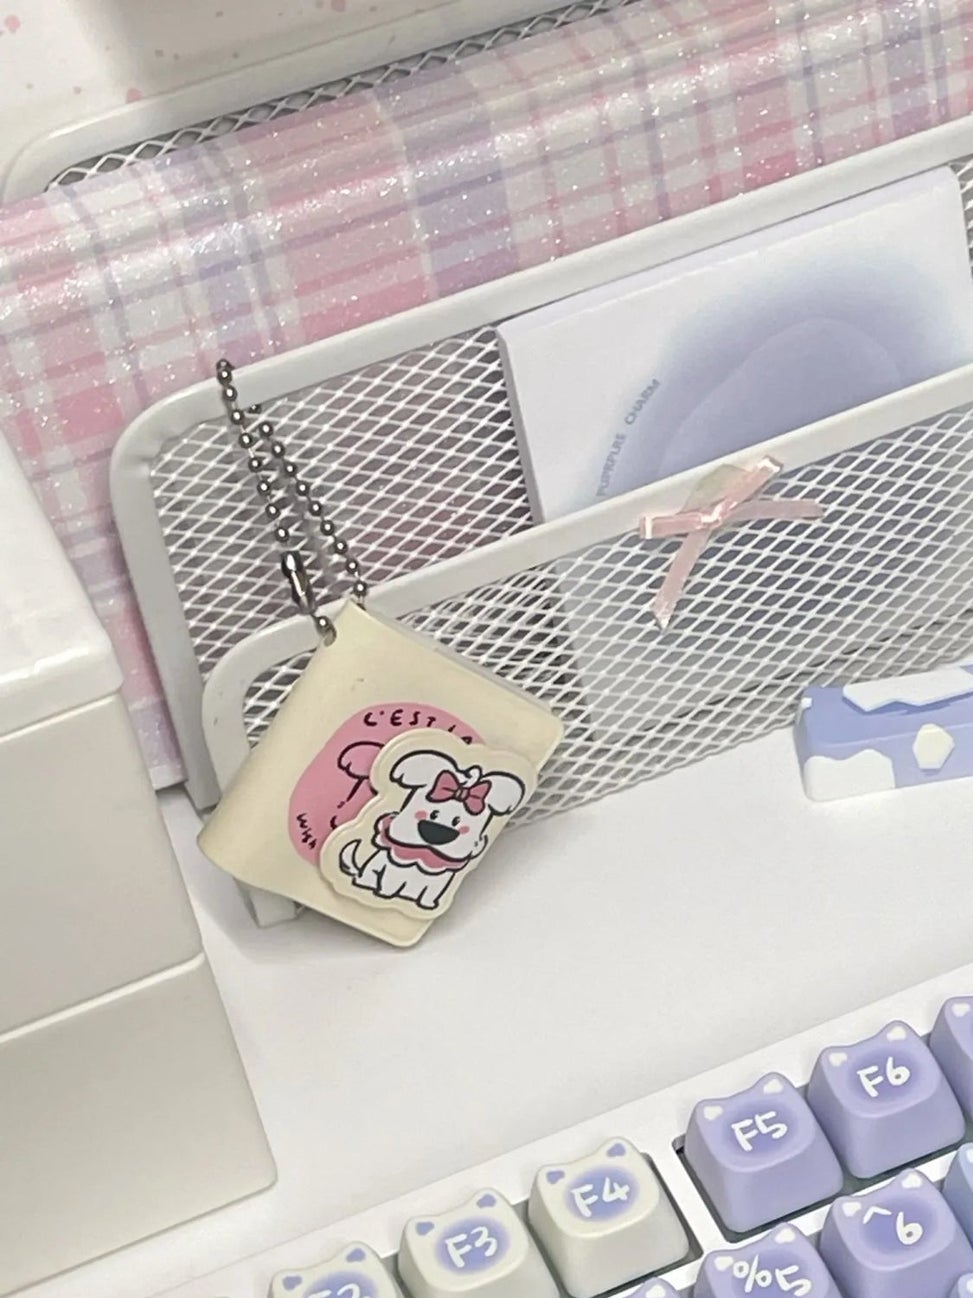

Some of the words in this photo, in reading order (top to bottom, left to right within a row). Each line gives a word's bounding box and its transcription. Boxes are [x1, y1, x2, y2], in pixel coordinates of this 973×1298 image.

[624, 379, 661, 425] CHARM
[857, 1057, 910, 1097] F6
[731, 1111, 788, 1151] F5
[571, 1178, 631, 1217] F4
[444, 1227, 497, 1267] F3
